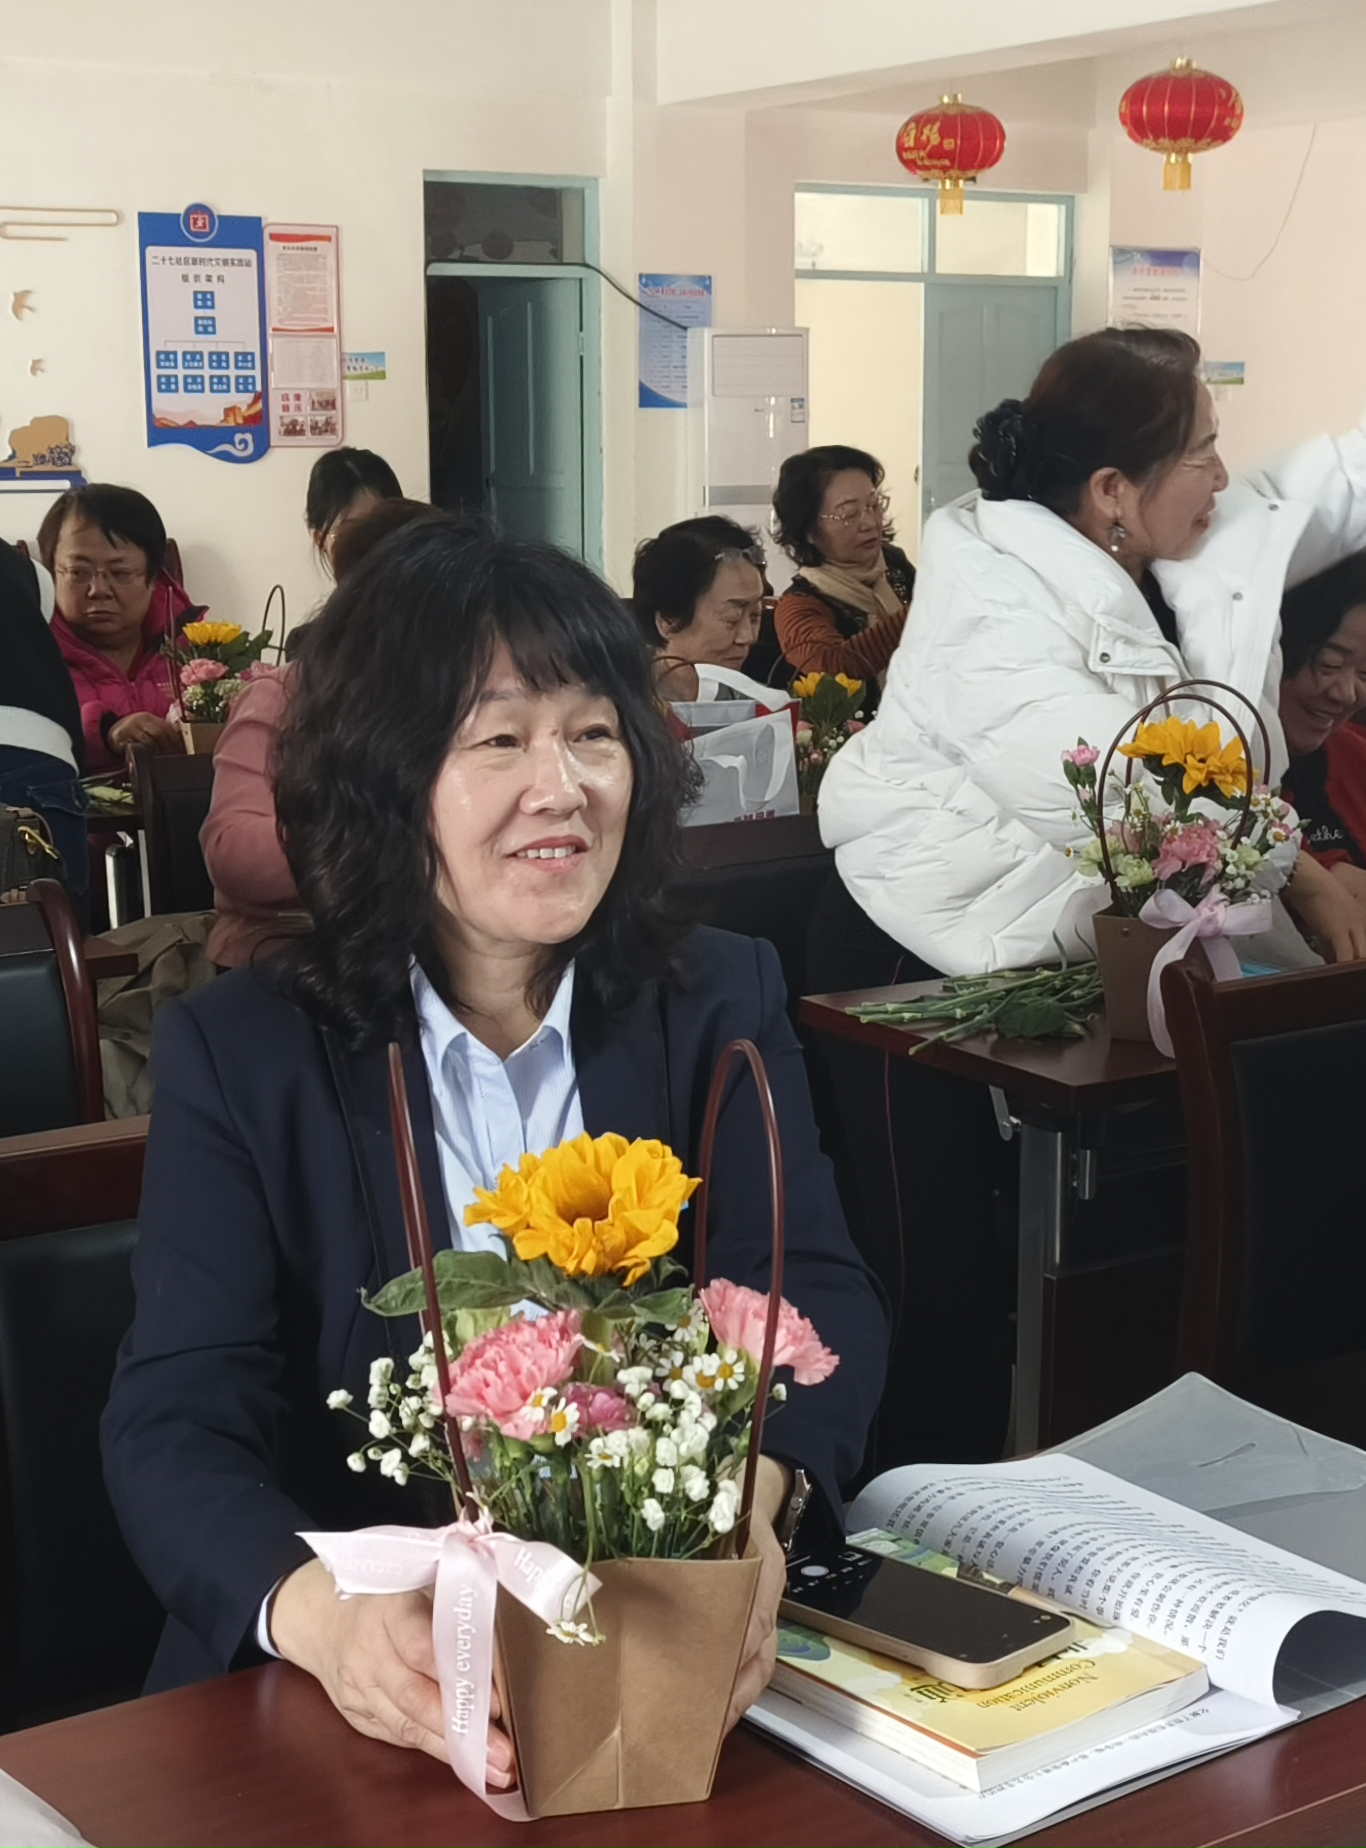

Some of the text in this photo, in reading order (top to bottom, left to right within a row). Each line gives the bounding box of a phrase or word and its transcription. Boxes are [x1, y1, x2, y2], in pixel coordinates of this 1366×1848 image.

[450, 1582, 479, 1735] Happy everyday
[975, 1658, 1096, 1709] Communication
[1009, 1672, 1099, 1713] Nonviolent
